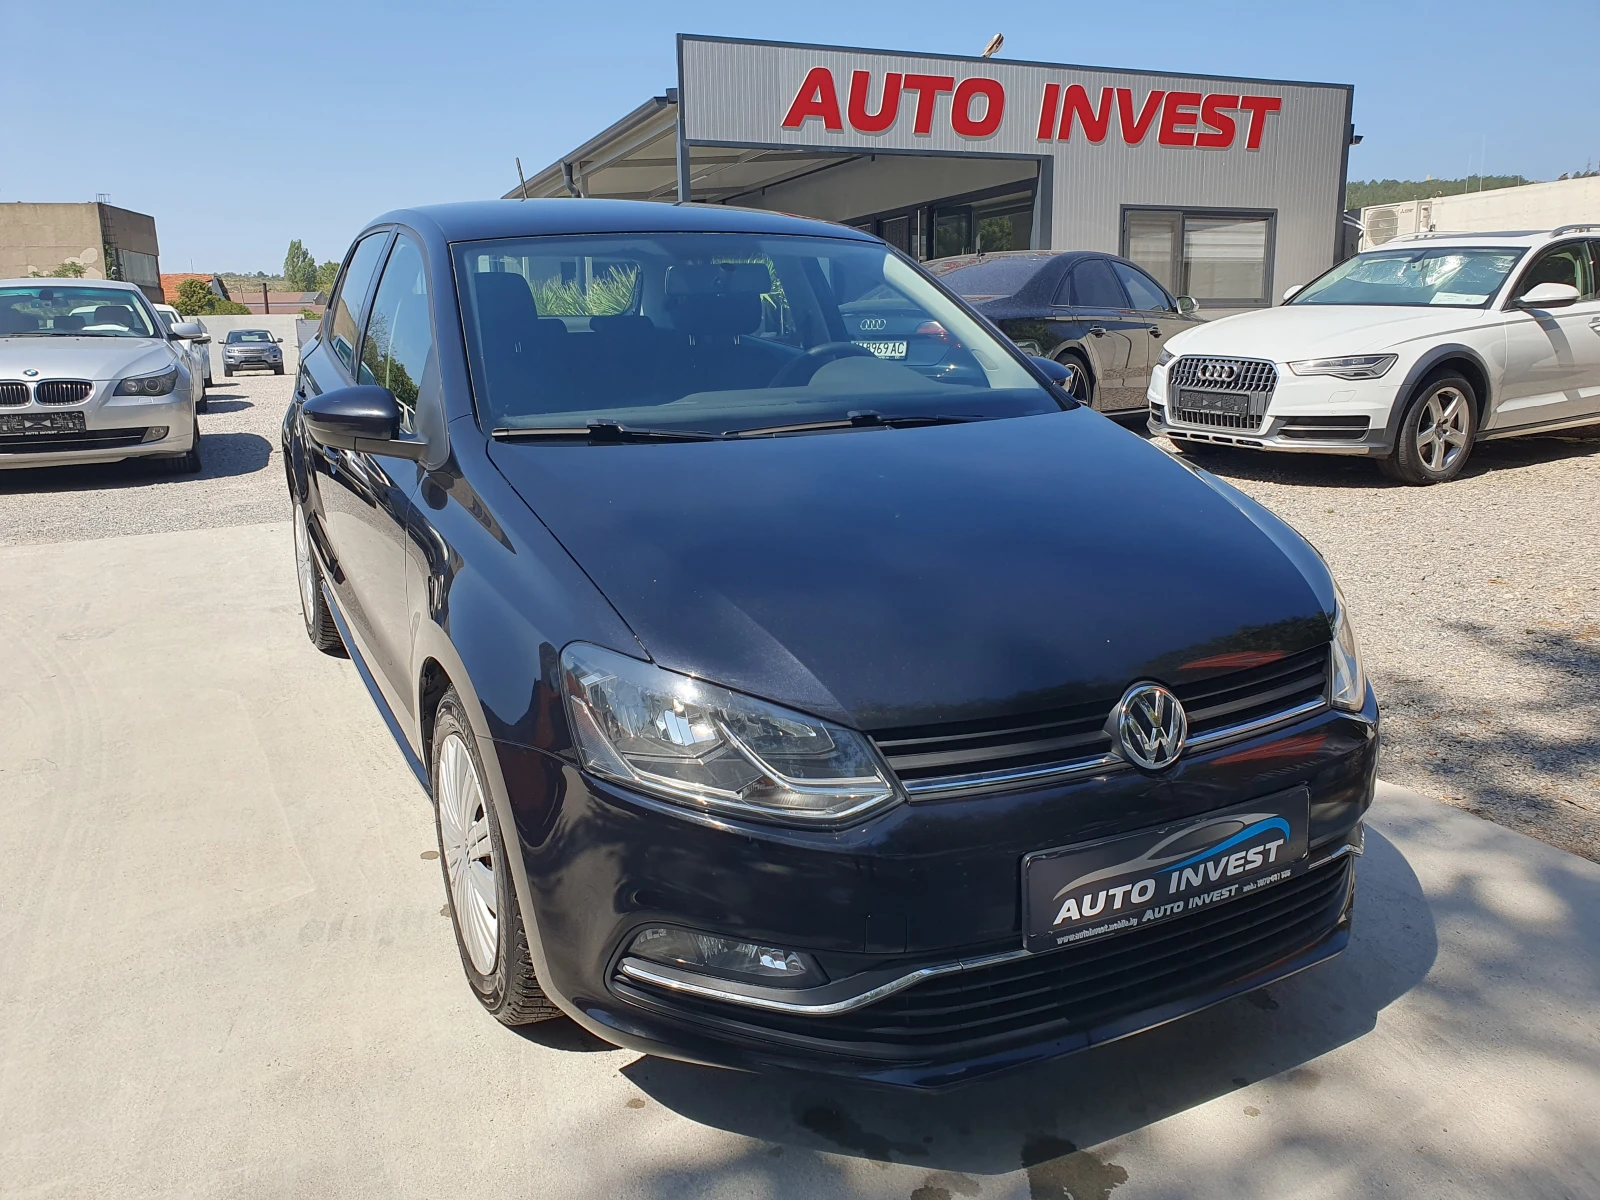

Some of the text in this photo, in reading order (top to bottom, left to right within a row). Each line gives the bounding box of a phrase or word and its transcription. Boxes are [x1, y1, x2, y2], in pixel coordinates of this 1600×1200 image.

[780, 66, 1283, 151] AUTO INVEST
[891, 342, 905, 355] AC
[1120, 684, 1186, 769] VW
[1053, 838, 1284, 925] AUTO INVEST
[1141, 901, 1184, 922] AUTO
[1188, 884, 1239, 909] INVEST
